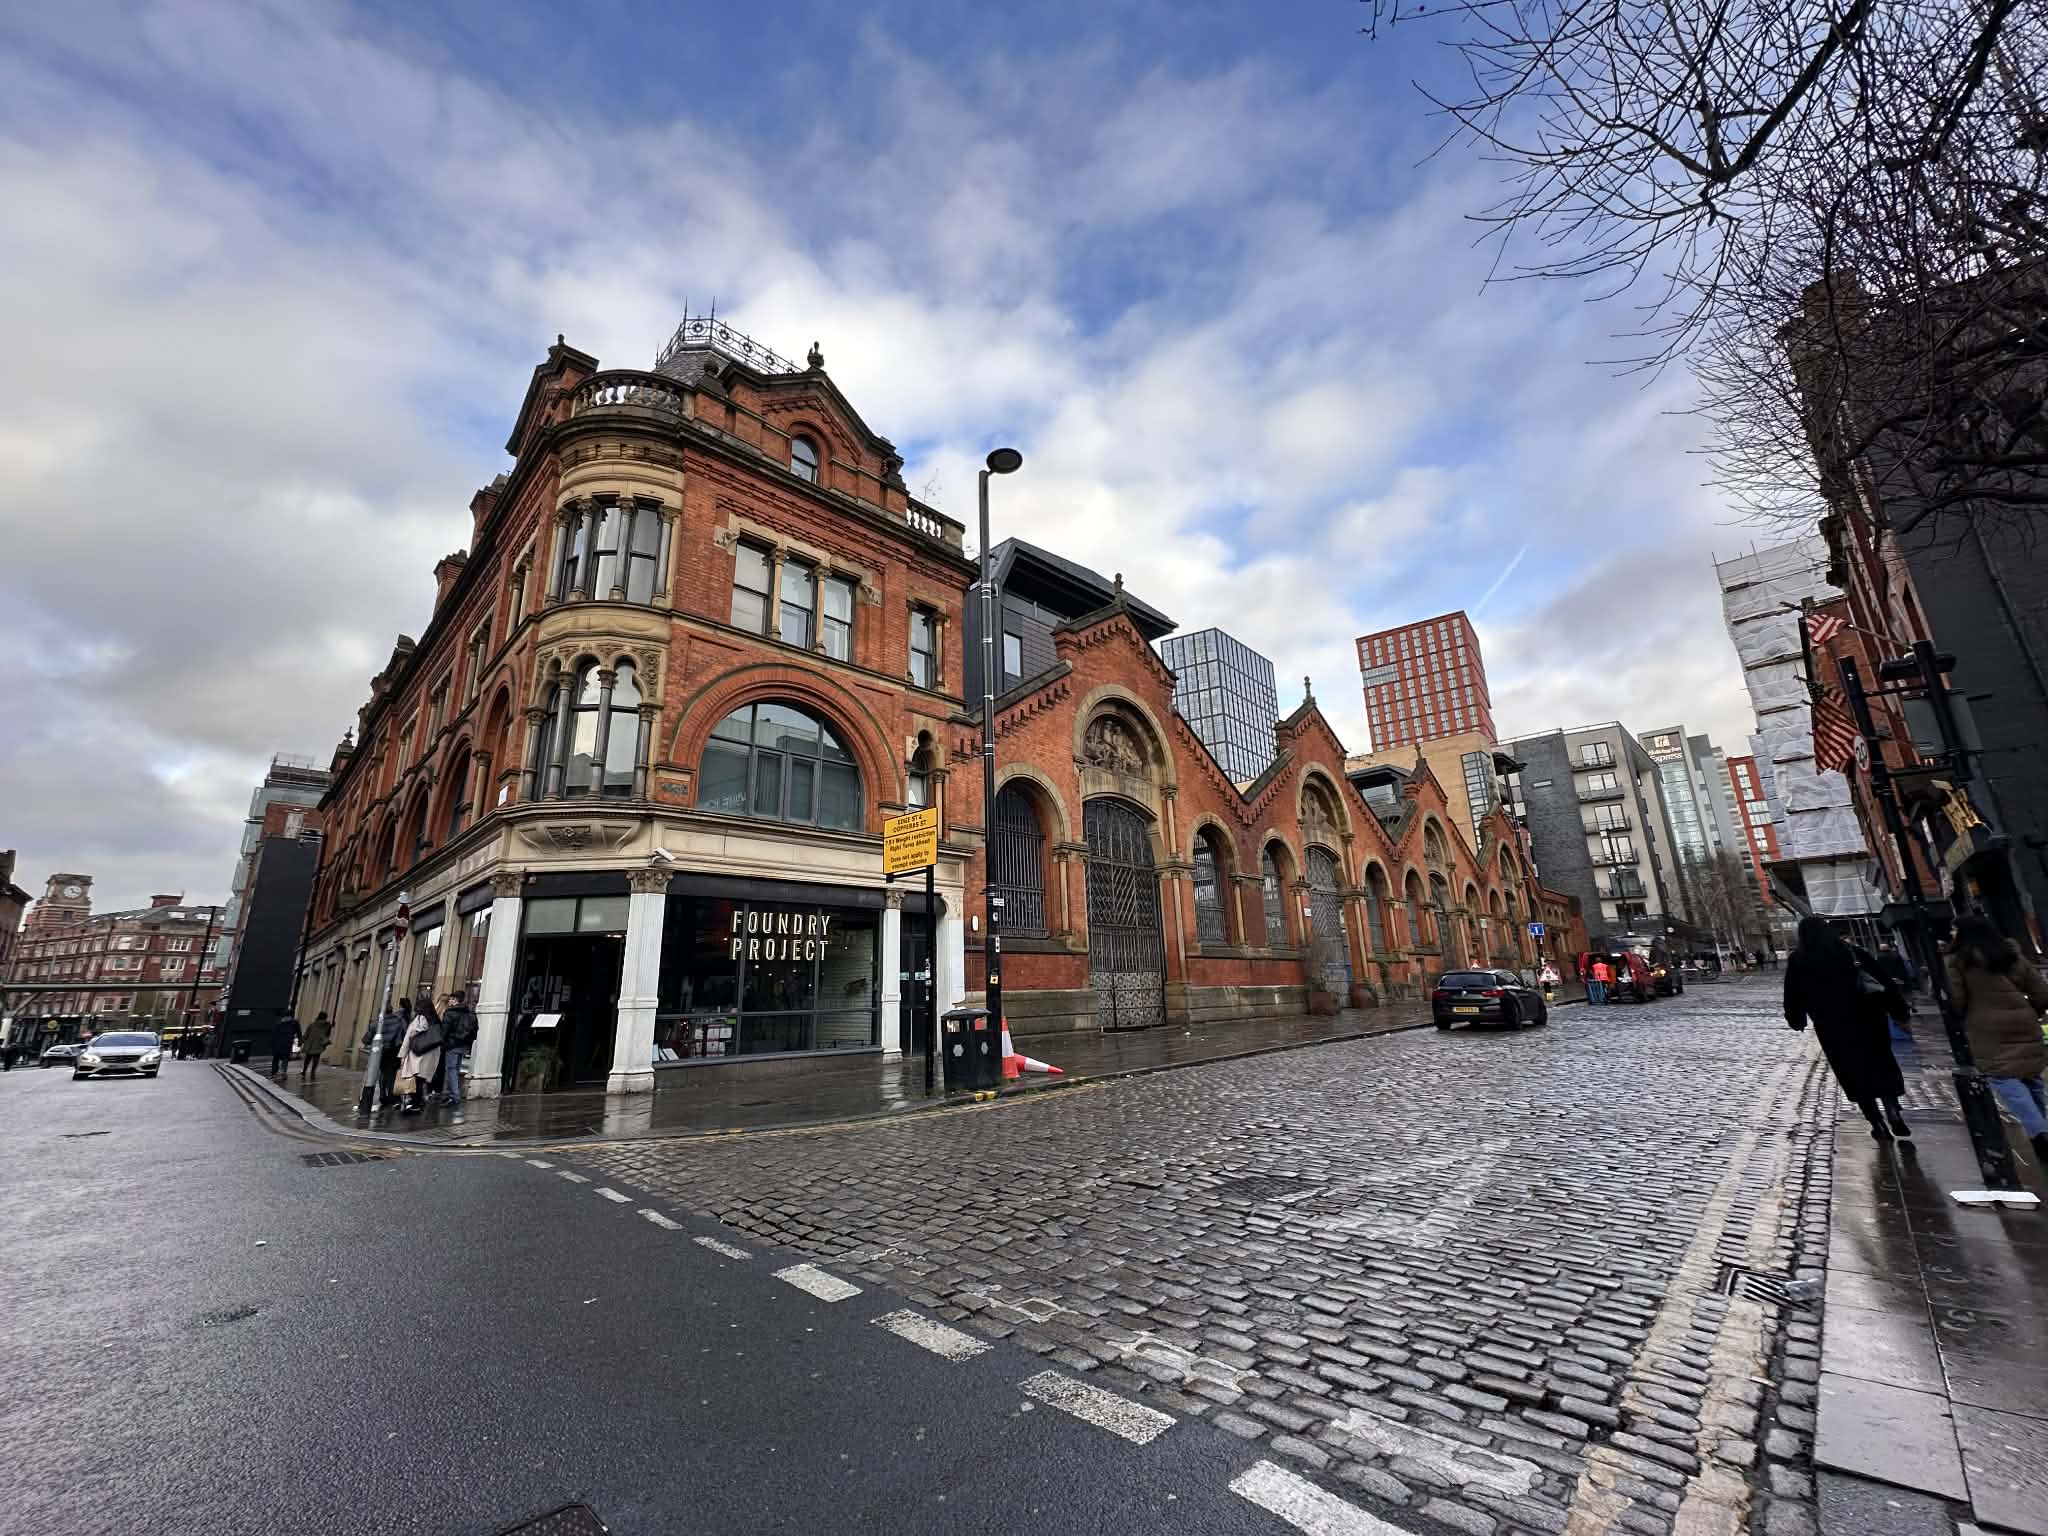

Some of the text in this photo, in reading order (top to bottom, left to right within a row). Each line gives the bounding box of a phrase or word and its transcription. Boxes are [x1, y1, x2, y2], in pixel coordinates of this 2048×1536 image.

[1856, 742, 1868, 768] 20
[920, 819, 927, 827] ST
[732, 910, 831, 936] FOUNDRY
[732, 937, 829, 961] PROJECT
